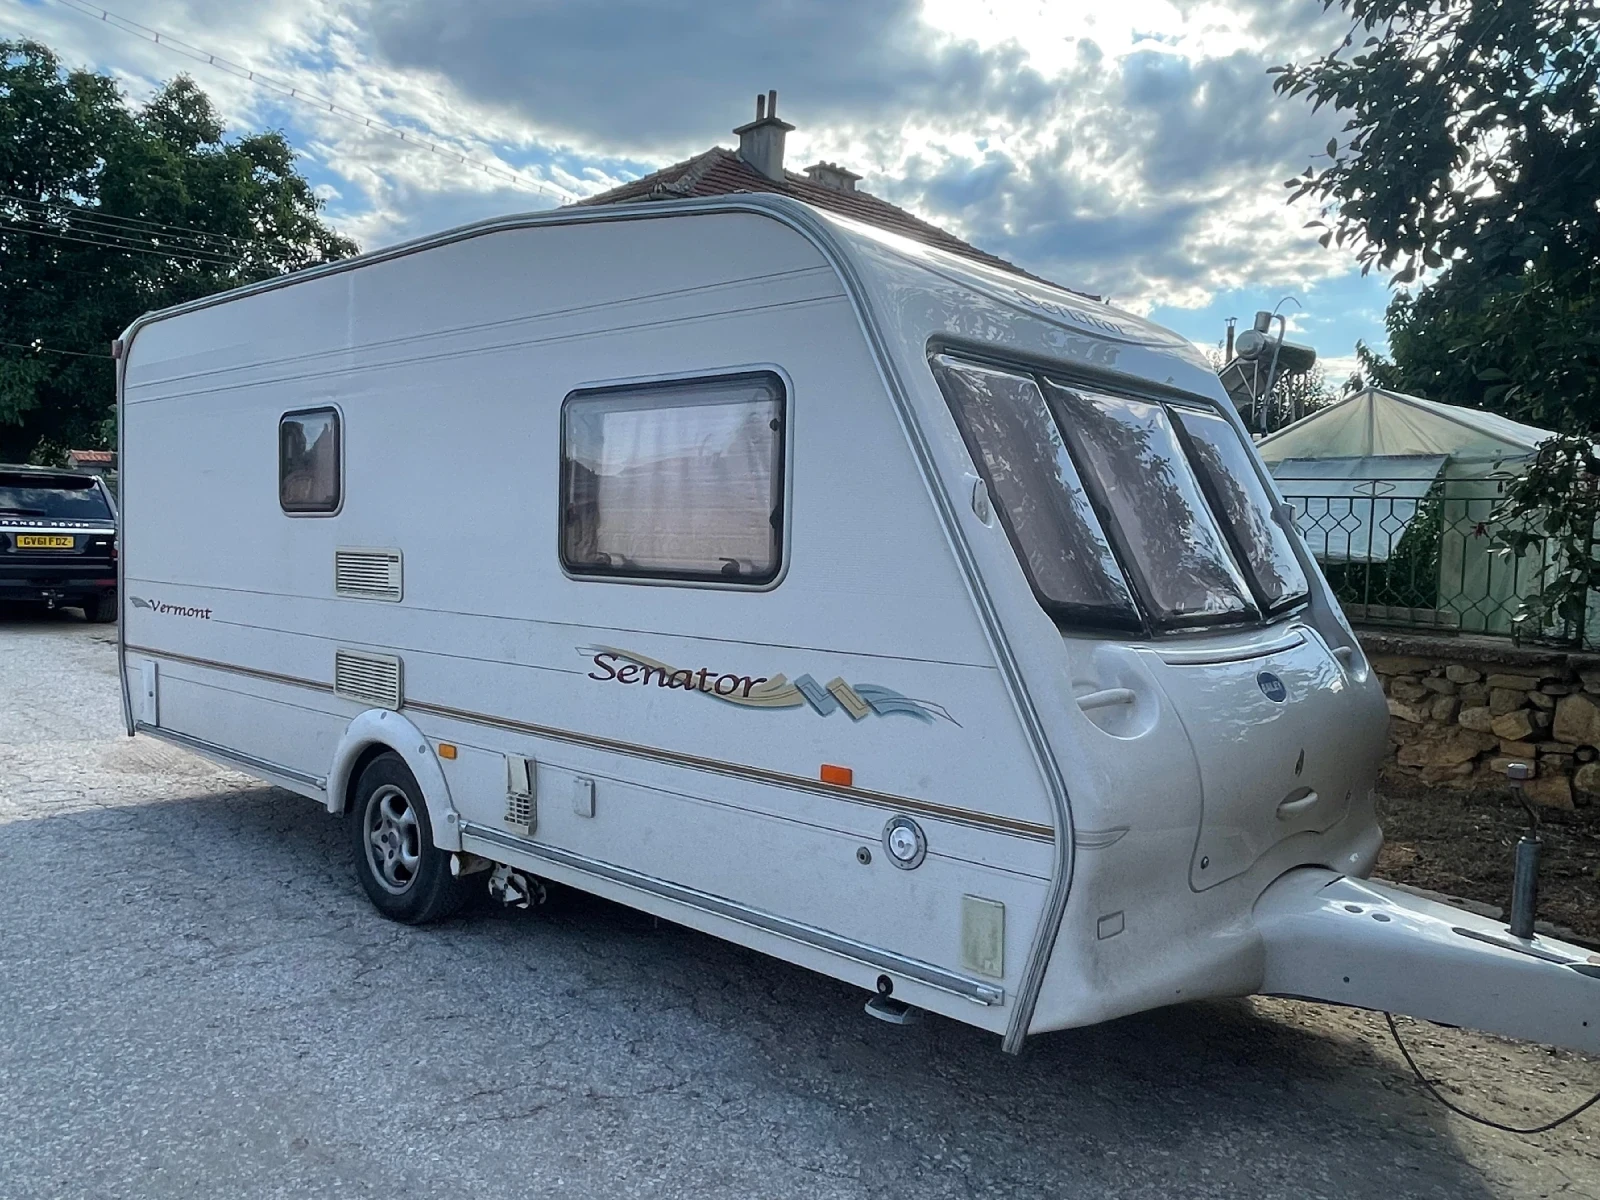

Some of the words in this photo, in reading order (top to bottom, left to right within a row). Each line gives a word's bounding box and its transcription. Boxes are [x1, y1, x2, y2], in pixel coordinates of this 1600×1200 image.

[23, 536, 46, 546] GV61
[48, 537, 68, 546] FDZ
[148, 599, 213, 620] Vermont
[588, 652, 767, 698] Senator
